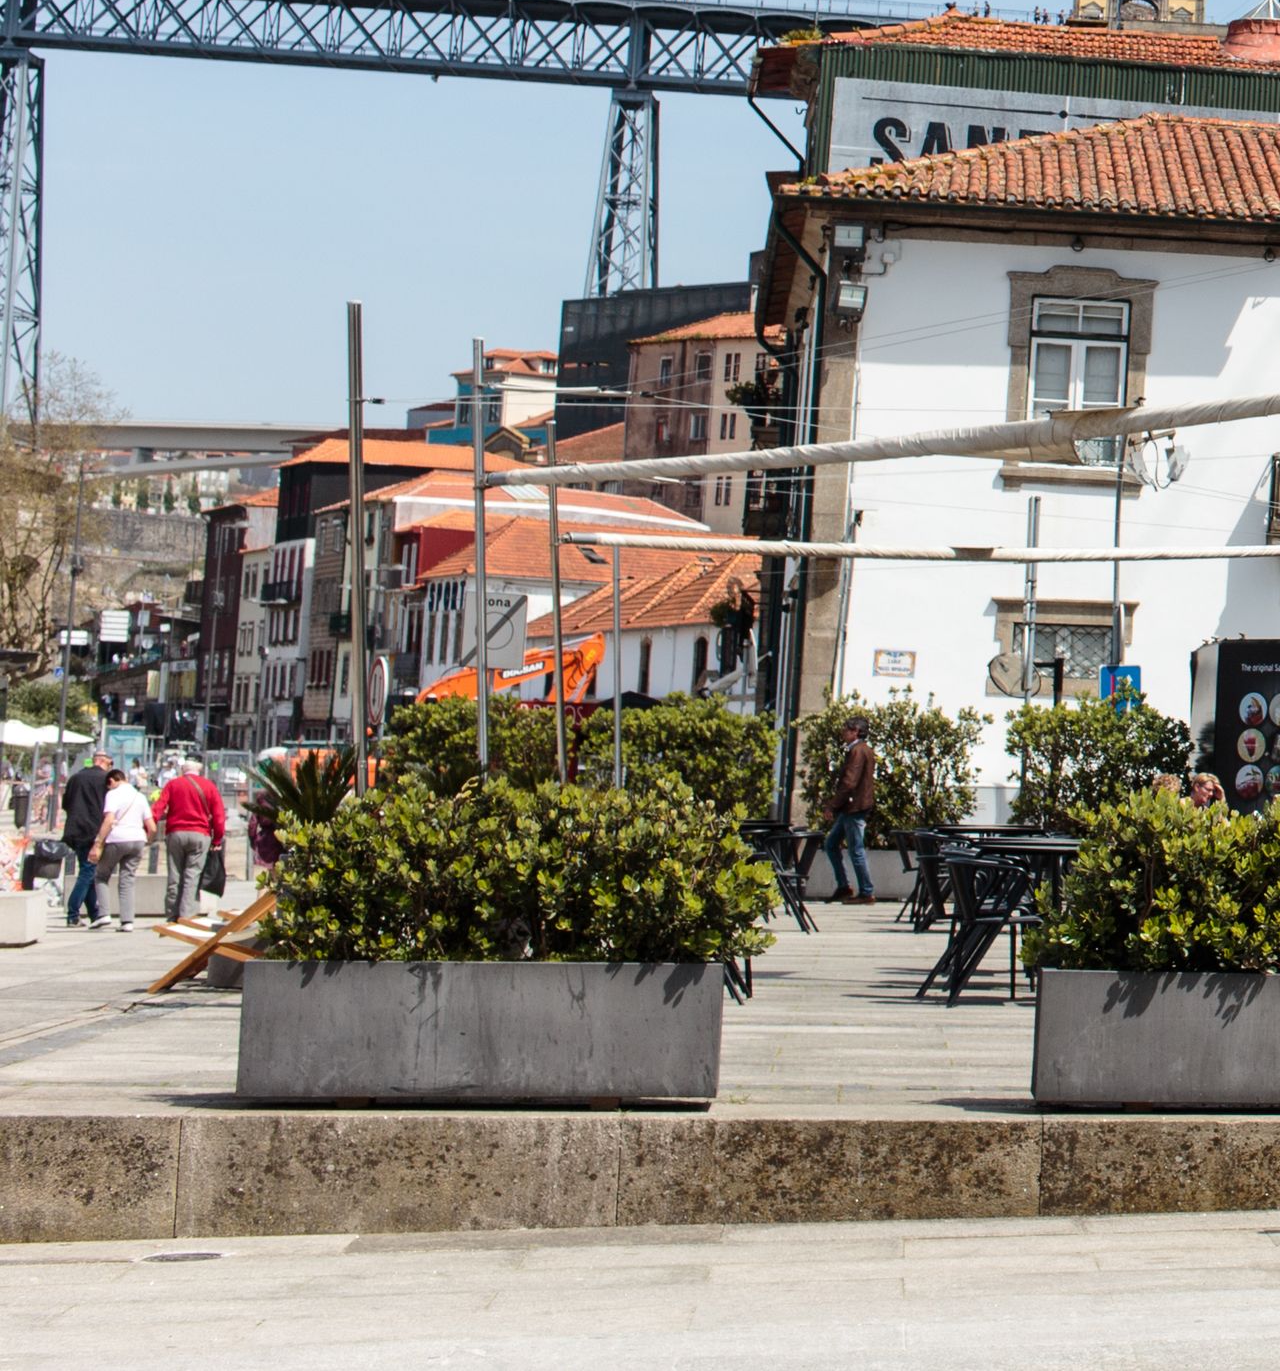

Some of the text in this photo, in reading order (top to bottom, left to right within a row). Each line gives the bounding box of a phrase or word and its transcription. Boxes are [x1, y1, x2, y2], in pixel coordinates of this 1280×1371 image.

[485, 597, 511, 608] ona
[1241, 663, 1251, 672] The
[1252, 663, 1274, 673] original
